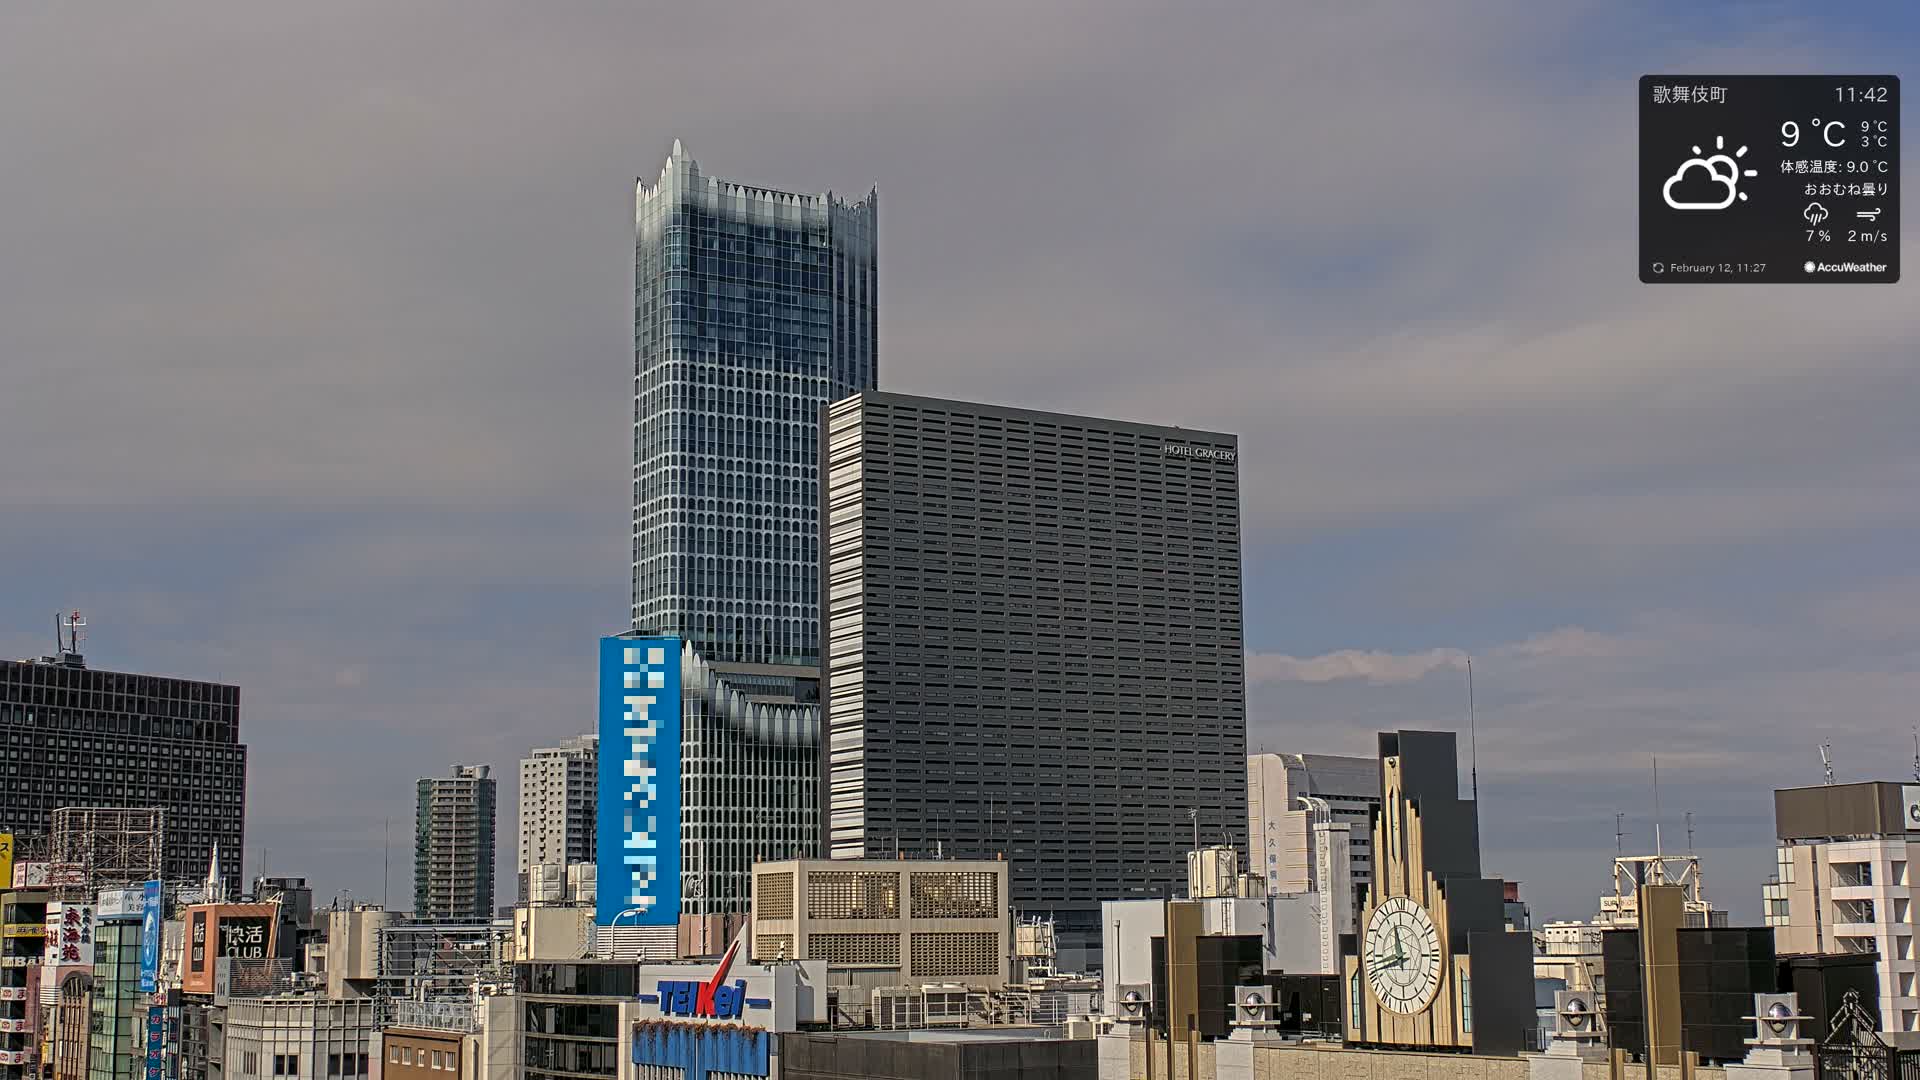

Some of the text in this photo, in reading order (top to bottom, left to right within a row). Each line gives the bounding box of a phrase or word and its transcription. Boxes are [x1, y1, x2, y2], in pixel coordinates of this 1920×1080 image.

[1164, 445, 1236, 460] HOTEL GRACERY
[62, 907, 81, 961] 東海苑
[228, 925, 263, 944] 快活
[227, 946, 262, 959] CLUB
